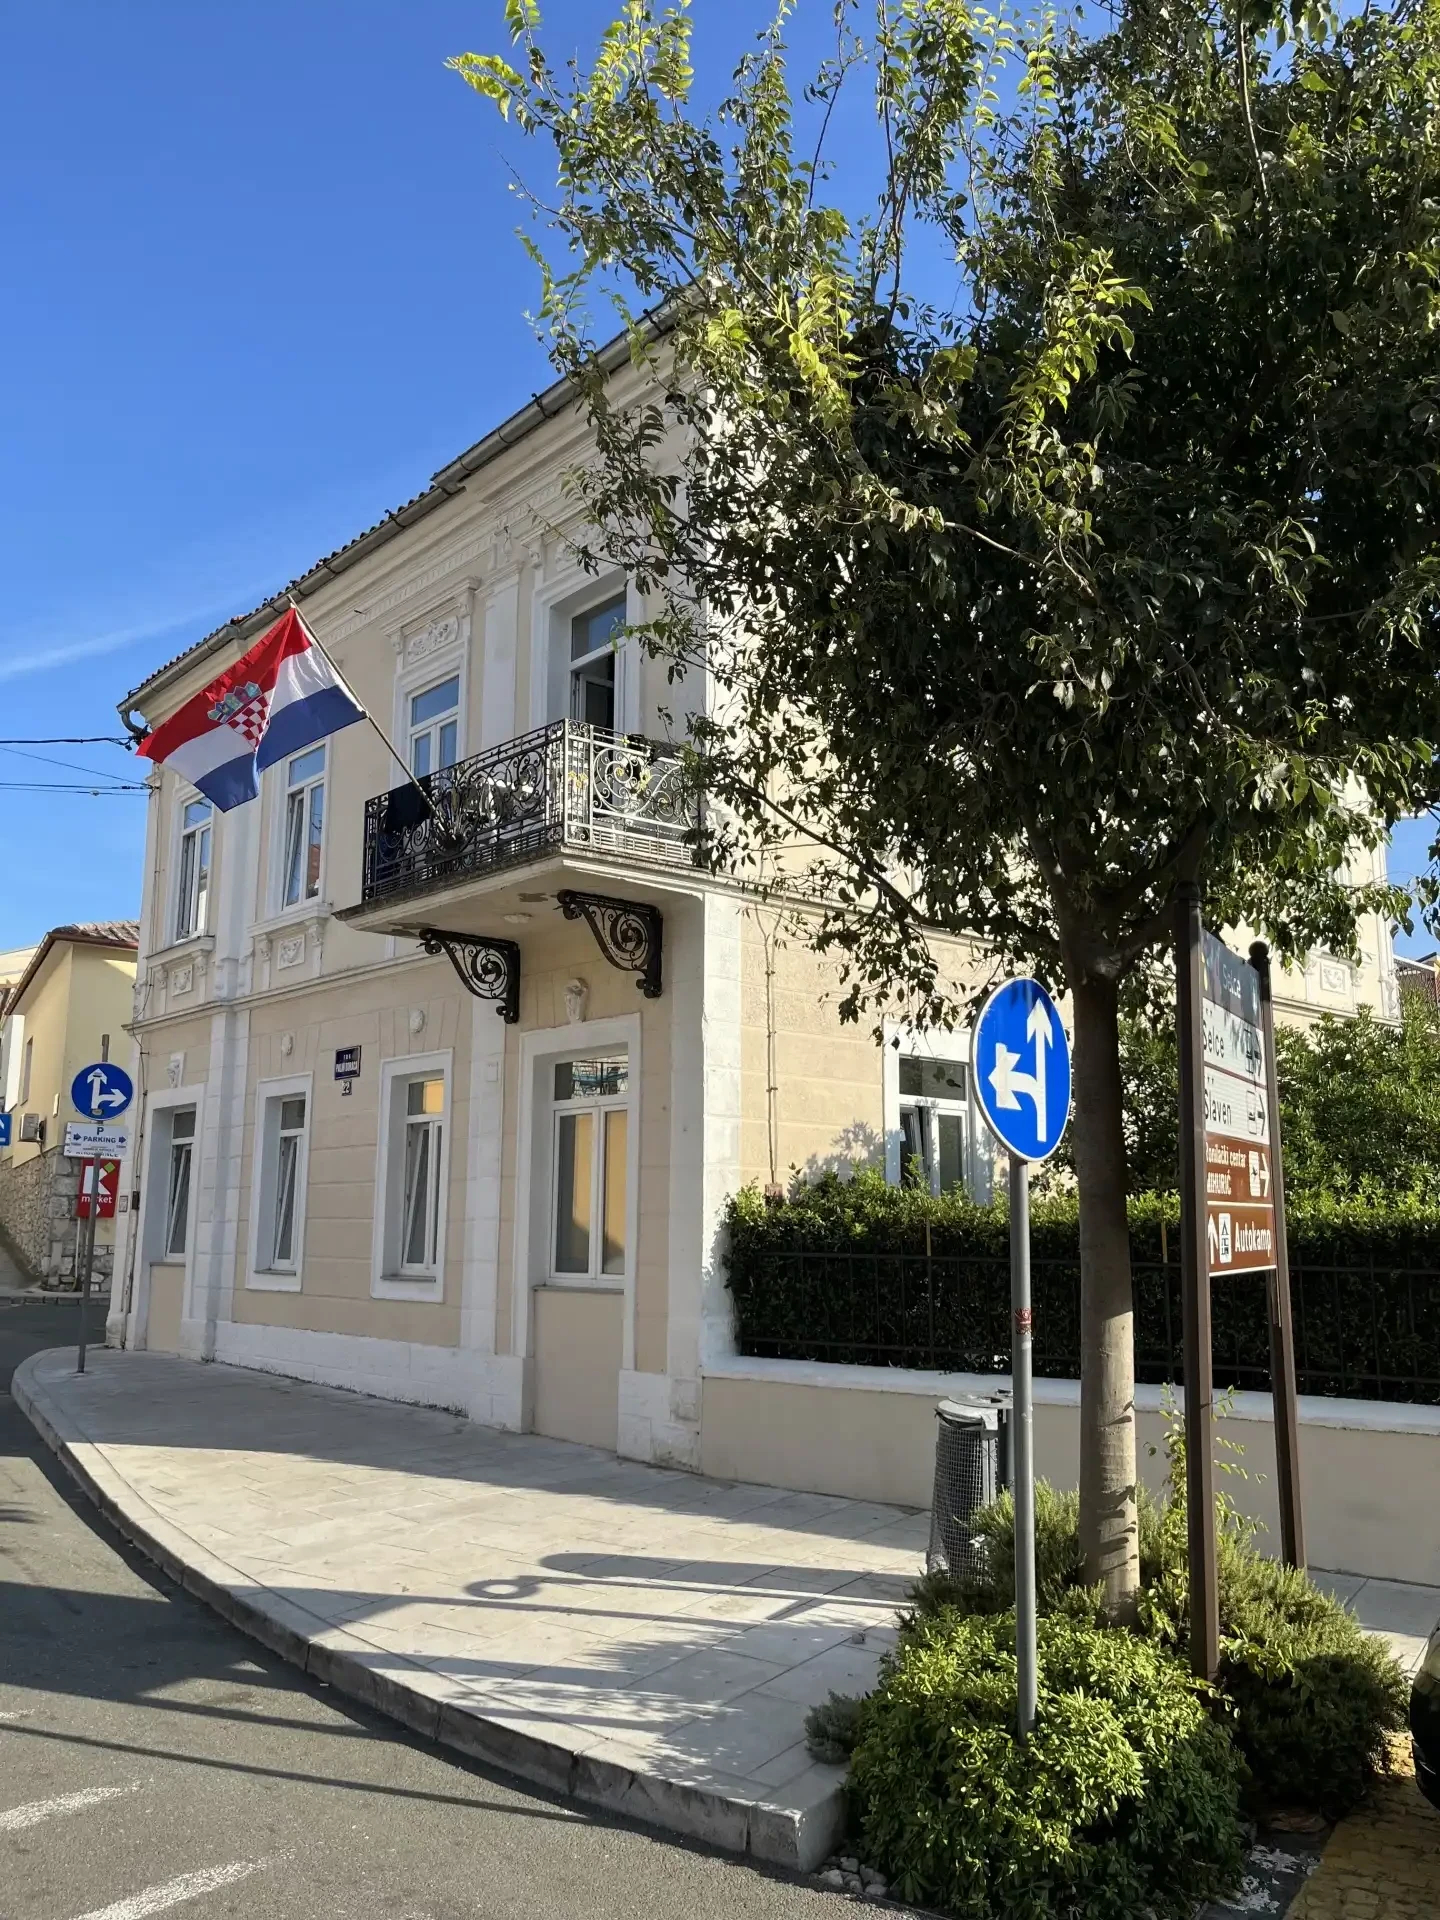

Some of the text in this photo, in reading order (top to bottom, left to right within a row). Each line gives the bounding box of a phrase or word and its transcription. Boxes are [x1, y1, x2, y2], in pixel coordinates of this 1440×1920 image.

[1202, 1019, 1225, 1058] Selce
[1204, 1088, 1232, 1125] Slaven
[83, 1135, 117, 1143] PARKING
[96, 1127, 104, 1135] P
[1229, 1149, 1246, 1168] centar
[1235, 1220, 1271, 1258] Autokamp
